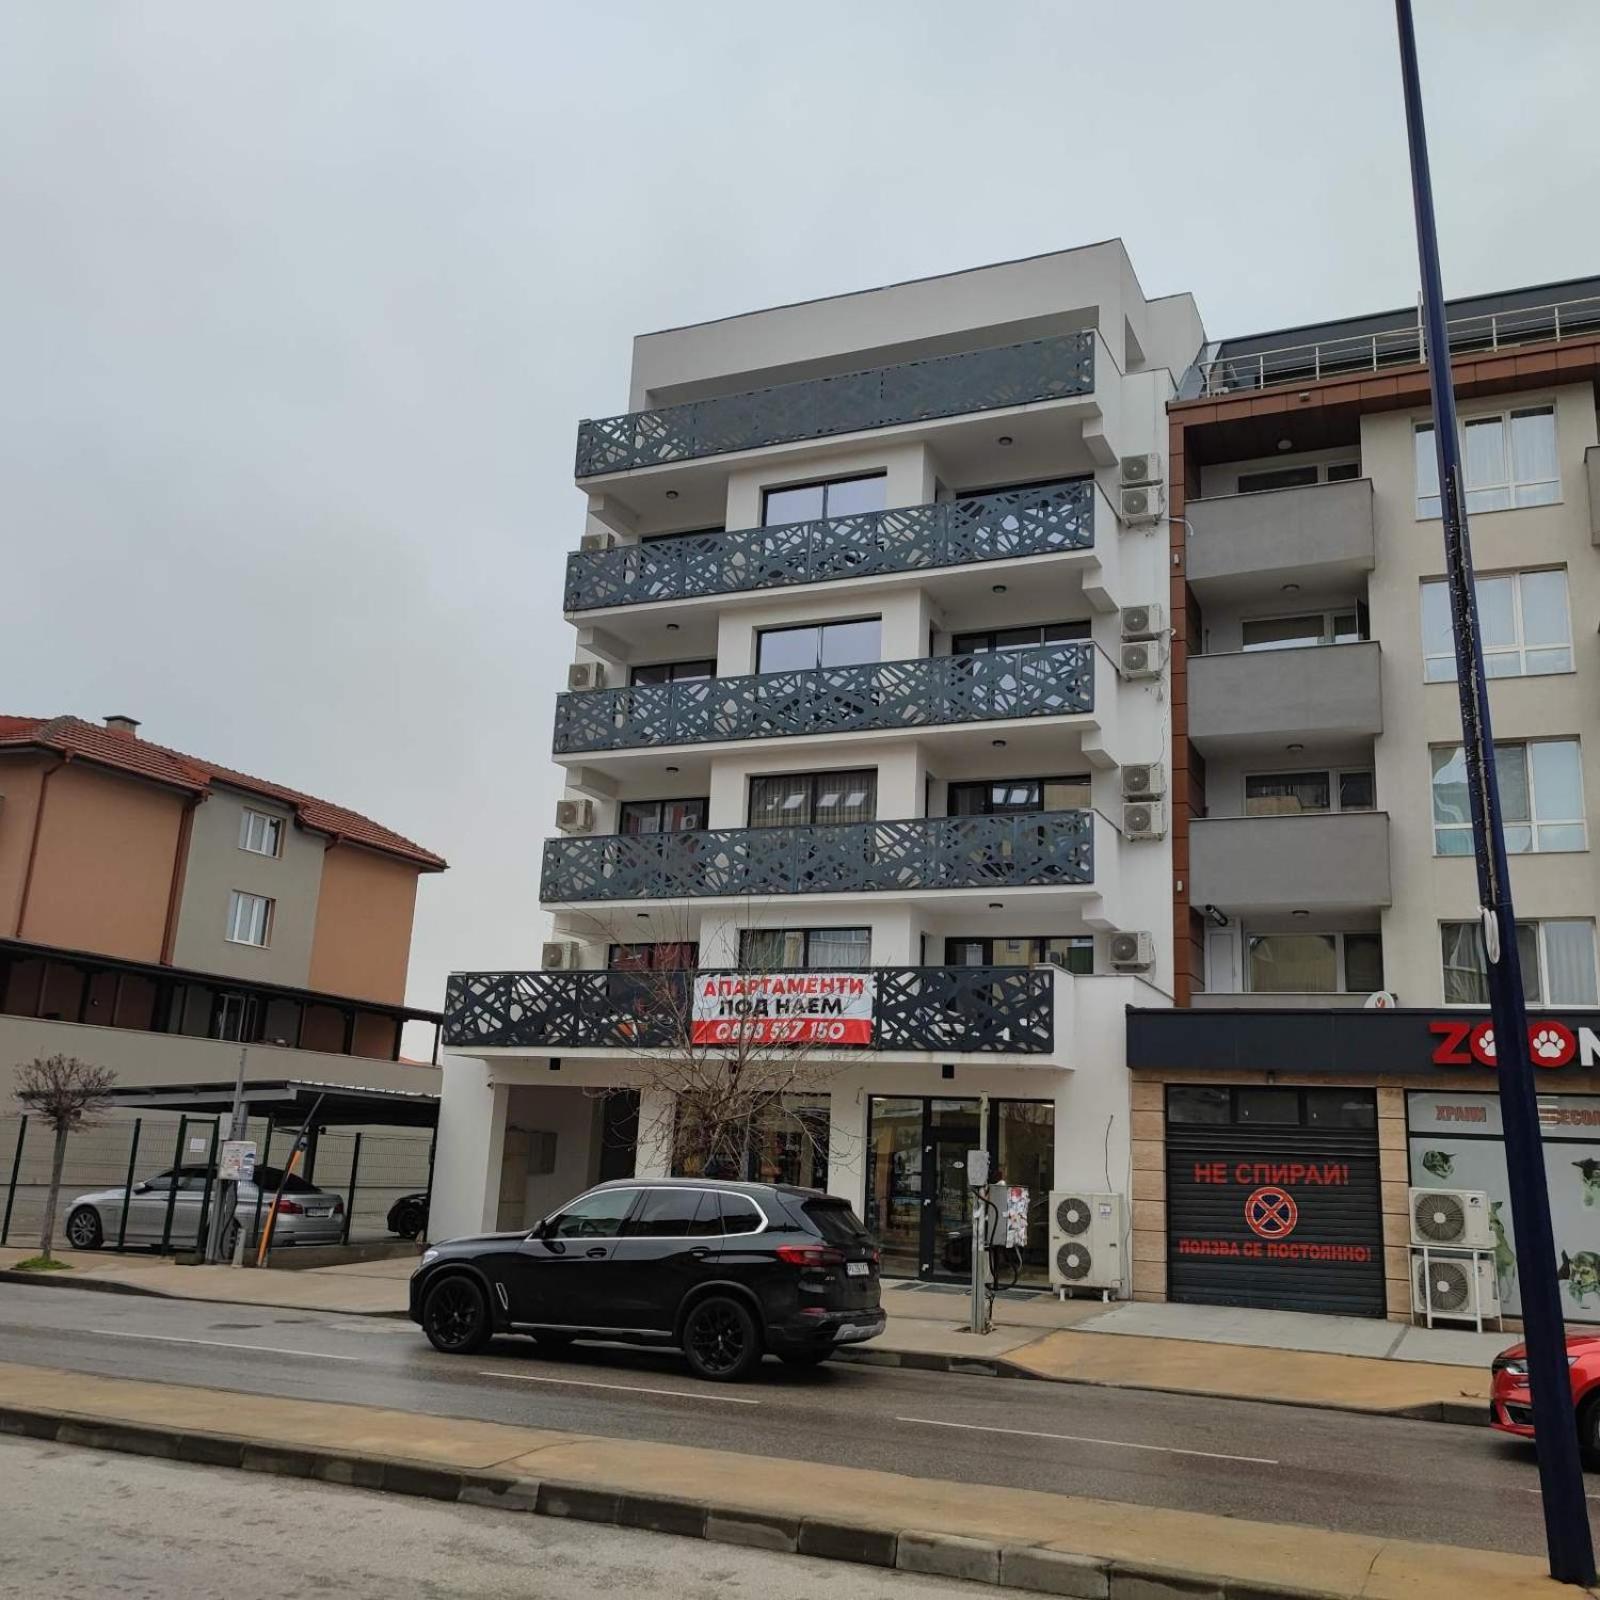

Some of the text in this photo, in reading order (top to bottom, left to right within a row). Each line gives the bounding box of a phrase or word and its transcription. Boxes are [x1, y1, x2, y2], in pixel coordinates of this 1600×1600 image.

[703, 977, 864, 997] АПАРТАМЕНТИ
[719, 998, 843, 1017] ПОД НАЕМ
[810, 1022, 846, 1040] 150
[1193, 1161, 1350, 1186] НЕ СПИРАЙ!
[1178, 1239, 1371, 1262] ПОЛЗВА СЕ ПОСТОЯННО!
